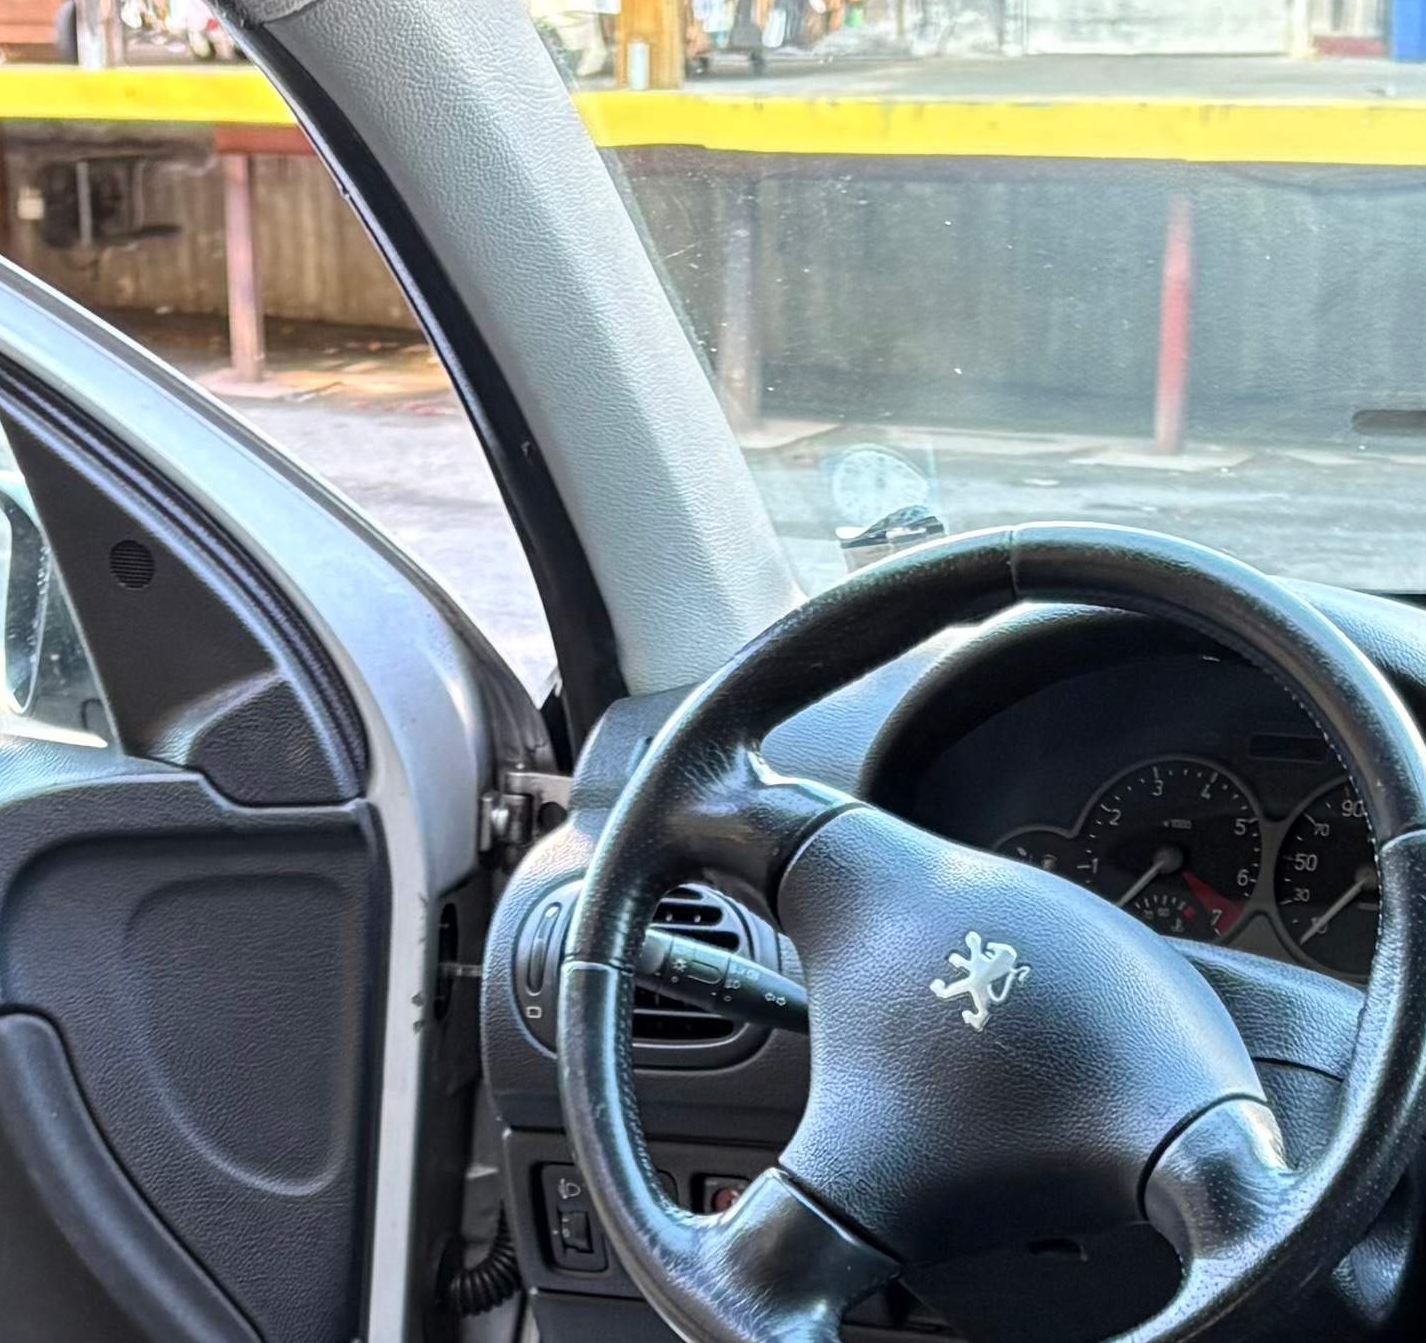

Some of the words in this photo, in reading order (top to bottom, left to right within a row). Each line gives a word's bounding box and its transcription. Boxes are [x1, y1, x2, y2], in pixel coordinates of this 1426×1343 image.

[1152, 779, 1165, 796] 3
[1200, 783, 1212, 799] 4
[1109, 809, 1122, 826] 2
[1341, 799, 1365, 818] 90
[1233, 818, 1248, 836] 5
[1313, 823, 1330, 837] 70
[1091, 857, 1099, 875] 1
[1294, 853, 1319, 872] 50
[1236, 869, 1249, 887] 6
[1293, 888, 1310, 903] 30
[1211, 908, 1223, 926] 7
